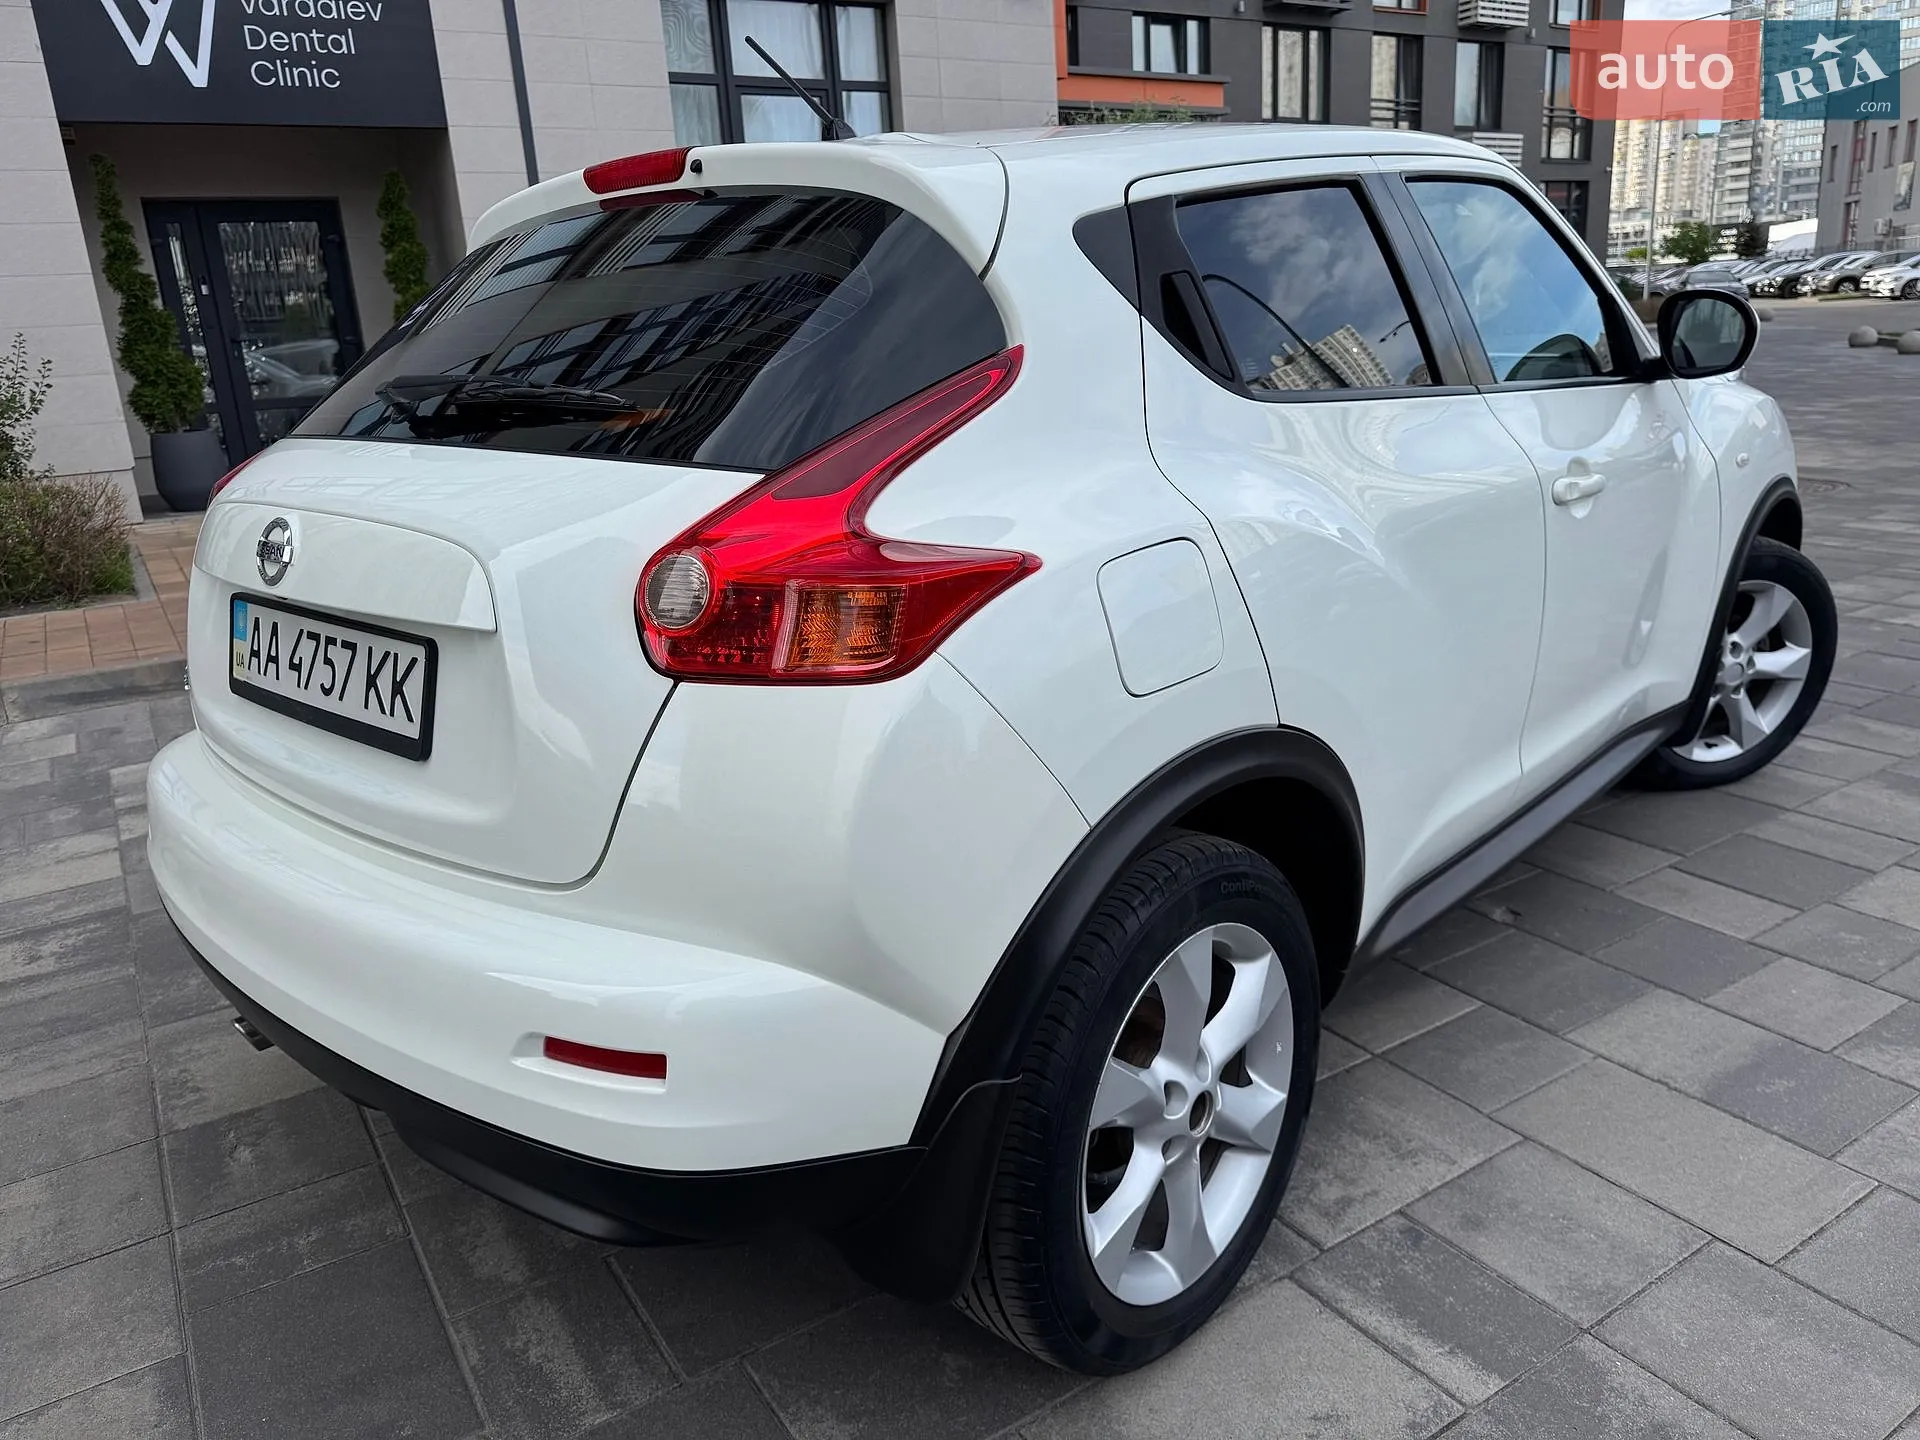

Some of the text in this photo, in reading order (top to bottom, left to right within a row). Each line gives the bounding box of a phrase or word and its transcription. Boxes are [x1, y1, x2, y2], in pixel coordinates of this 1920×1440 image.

[243, 24, 356, 55] Dental
[250, 59, 341, 88] Clinic
[235, 651, 245, 669] UA
[247, 616, 419, 724] AA 4757 KK
